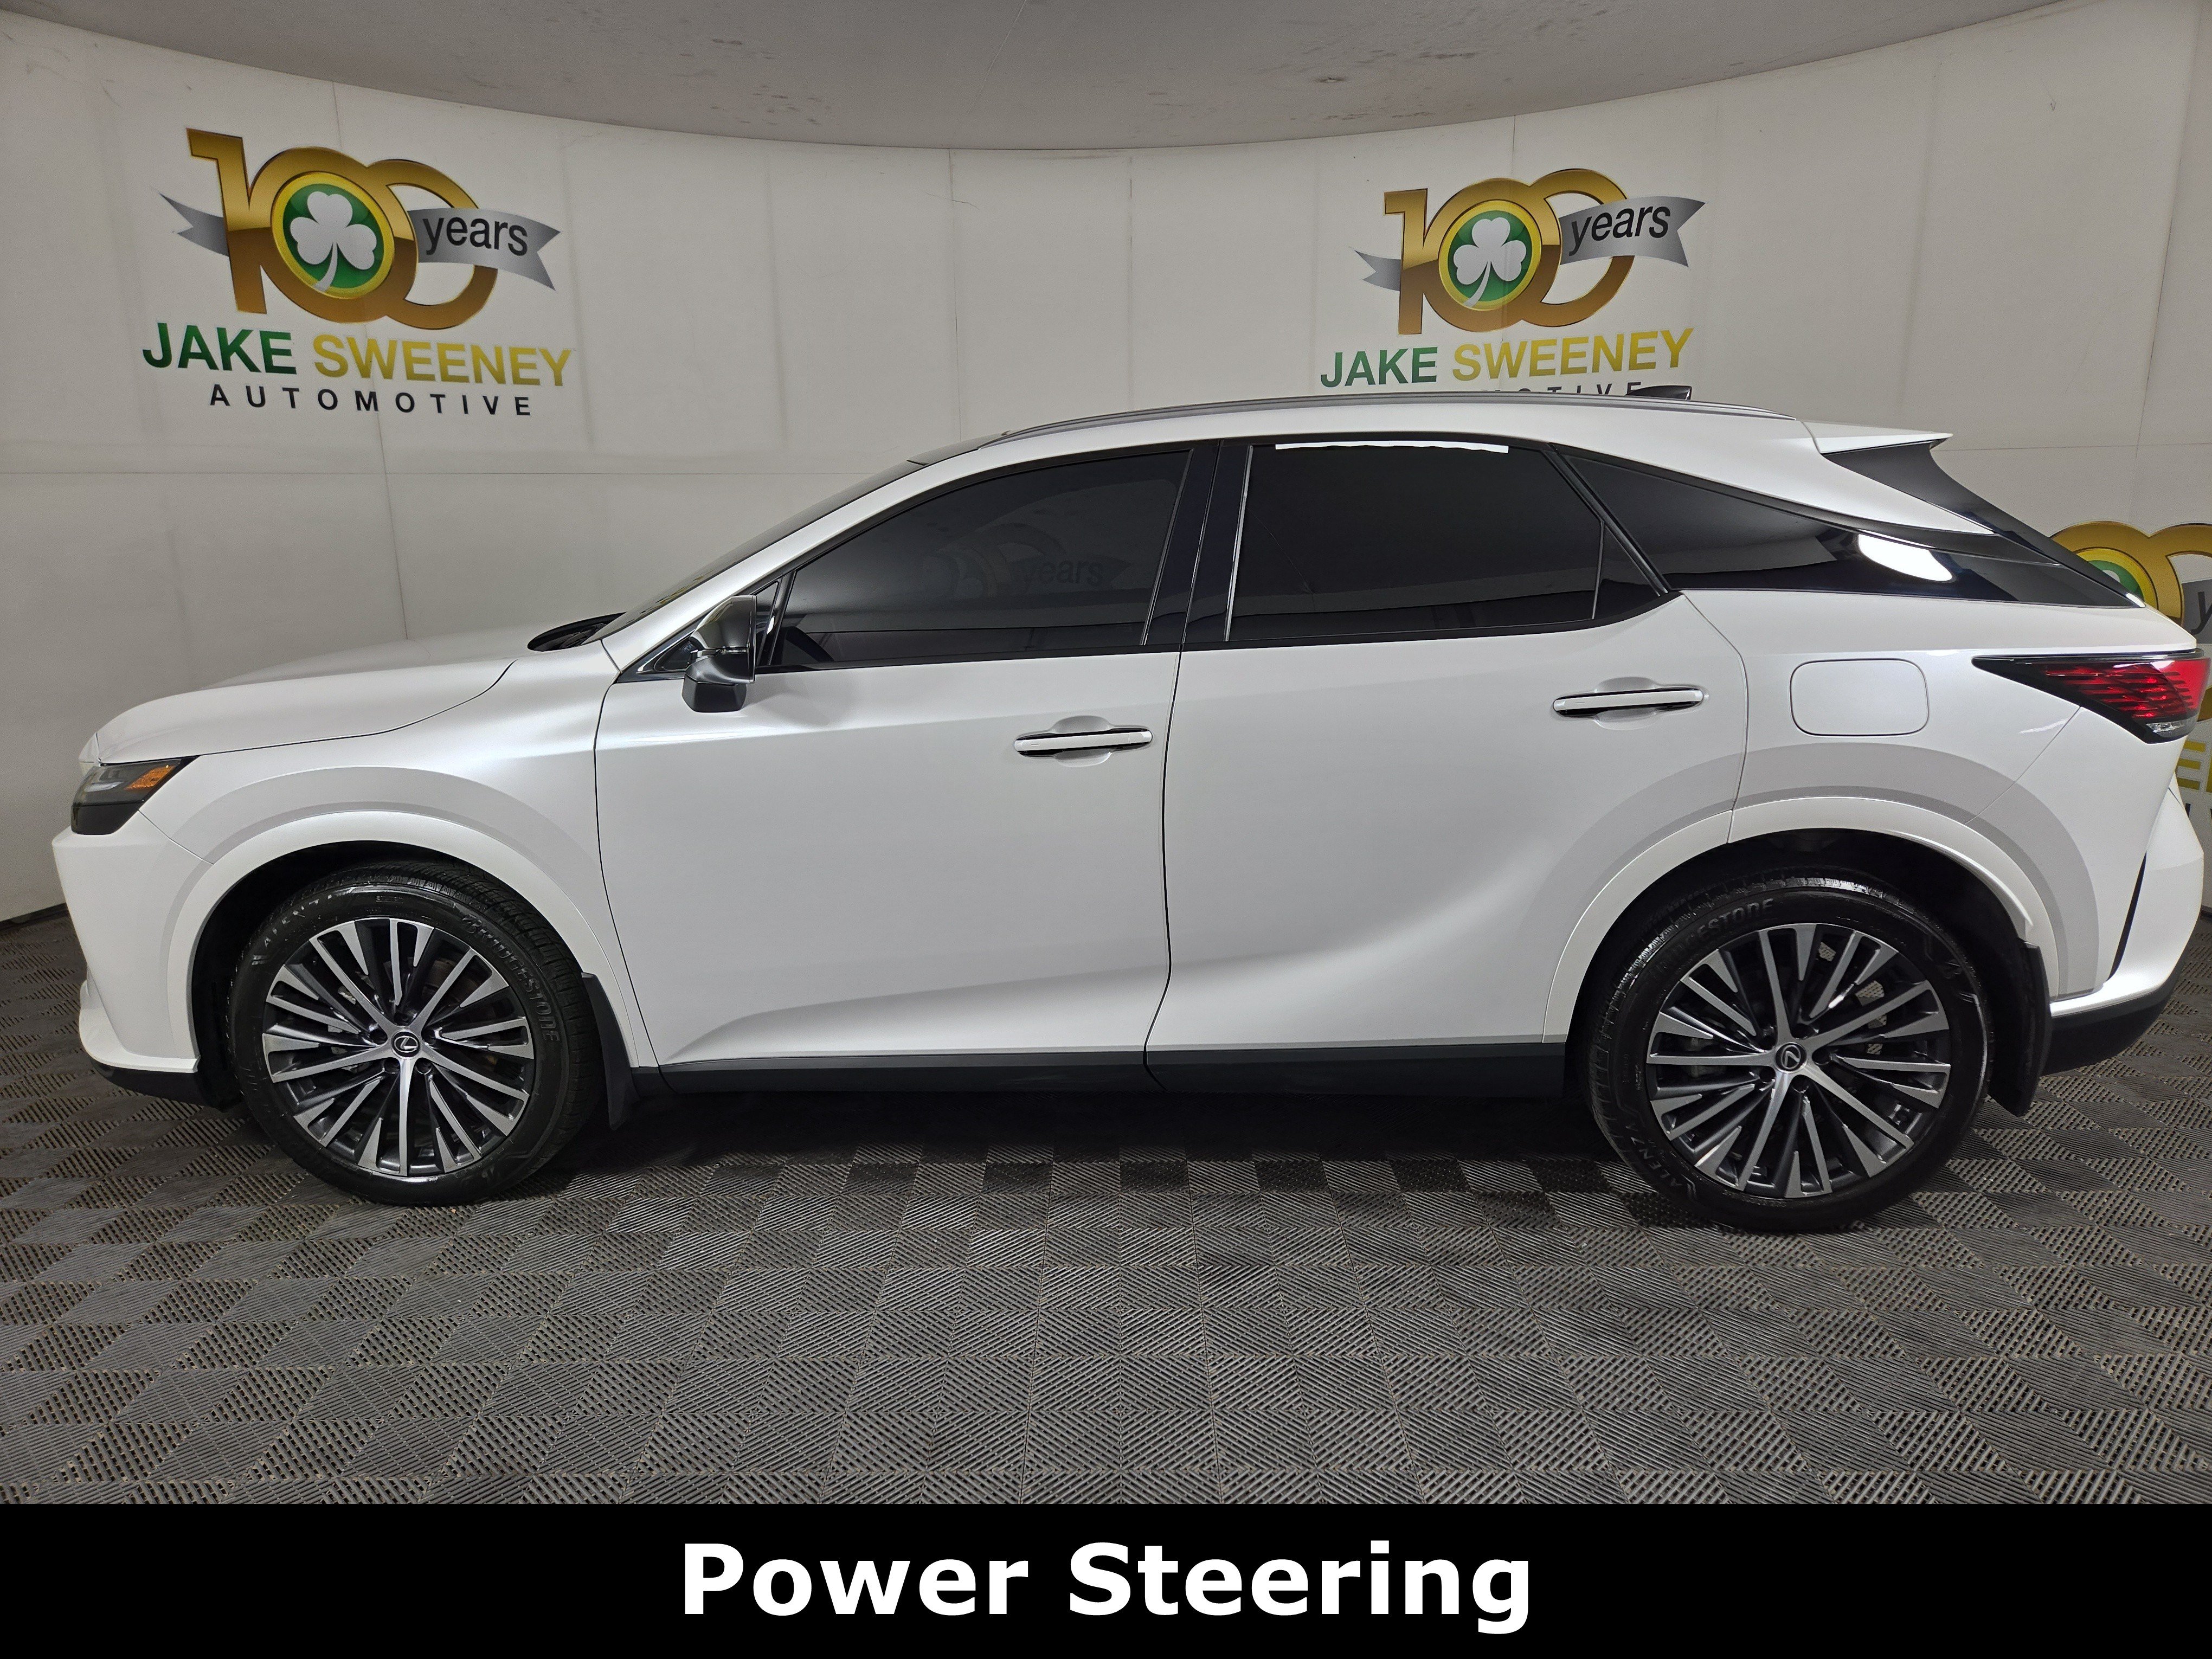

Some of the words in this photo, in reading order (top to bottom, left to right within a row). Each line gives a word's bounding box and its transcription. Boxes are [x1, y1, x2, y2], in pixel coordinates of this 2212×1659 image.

[423, 217, 529, 256] years
[1568, 205, 1671, 256] years
[142, 322, 297, 375] JAKE
[313, 334, 573, 387] SWEENEY
[1321, 346, 1438, 388] JAKE
[1452, 327, 1694, 381] SWEENEY
[210, 384, 531, 416] AUTOMOTIVE
